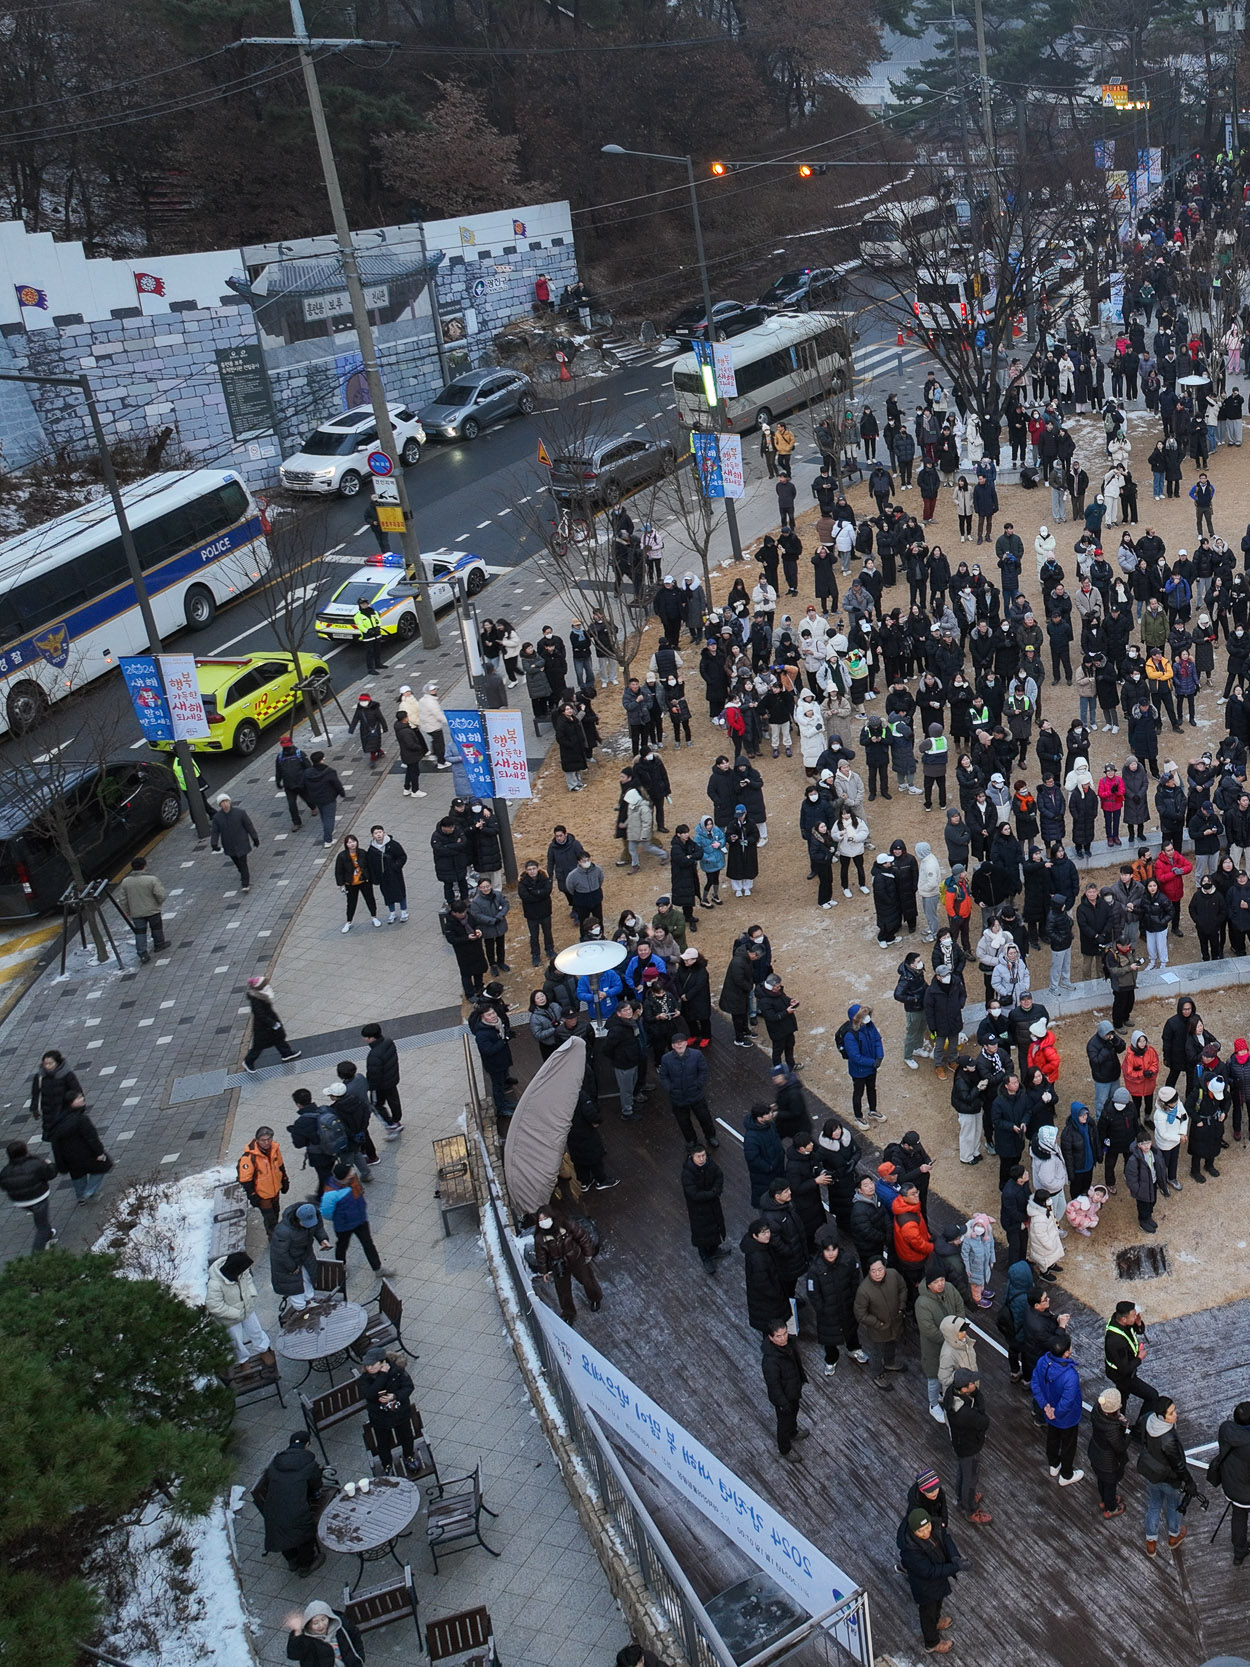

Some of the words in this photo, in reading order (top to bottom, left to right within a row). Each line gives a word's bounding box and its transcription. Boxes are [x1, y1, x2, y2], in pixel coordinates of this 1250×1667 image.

[328, 297, 343, 310] 보루
[200, 537, 232, 562] POLICE
[168, 672, 193, 691] 행복
[173, 691, 198, 702] 가득한
[254, 692, 268, 711] 119
[172, 701, 203, 713] 새해
[176, 712, 204, 722] 되세요
[492, 728, 517, 748] 행복
[495, 748, 523, 758] 가득한
[494, 758, 527, 771] 새해
[498, 771, 527, 781] 되세요
